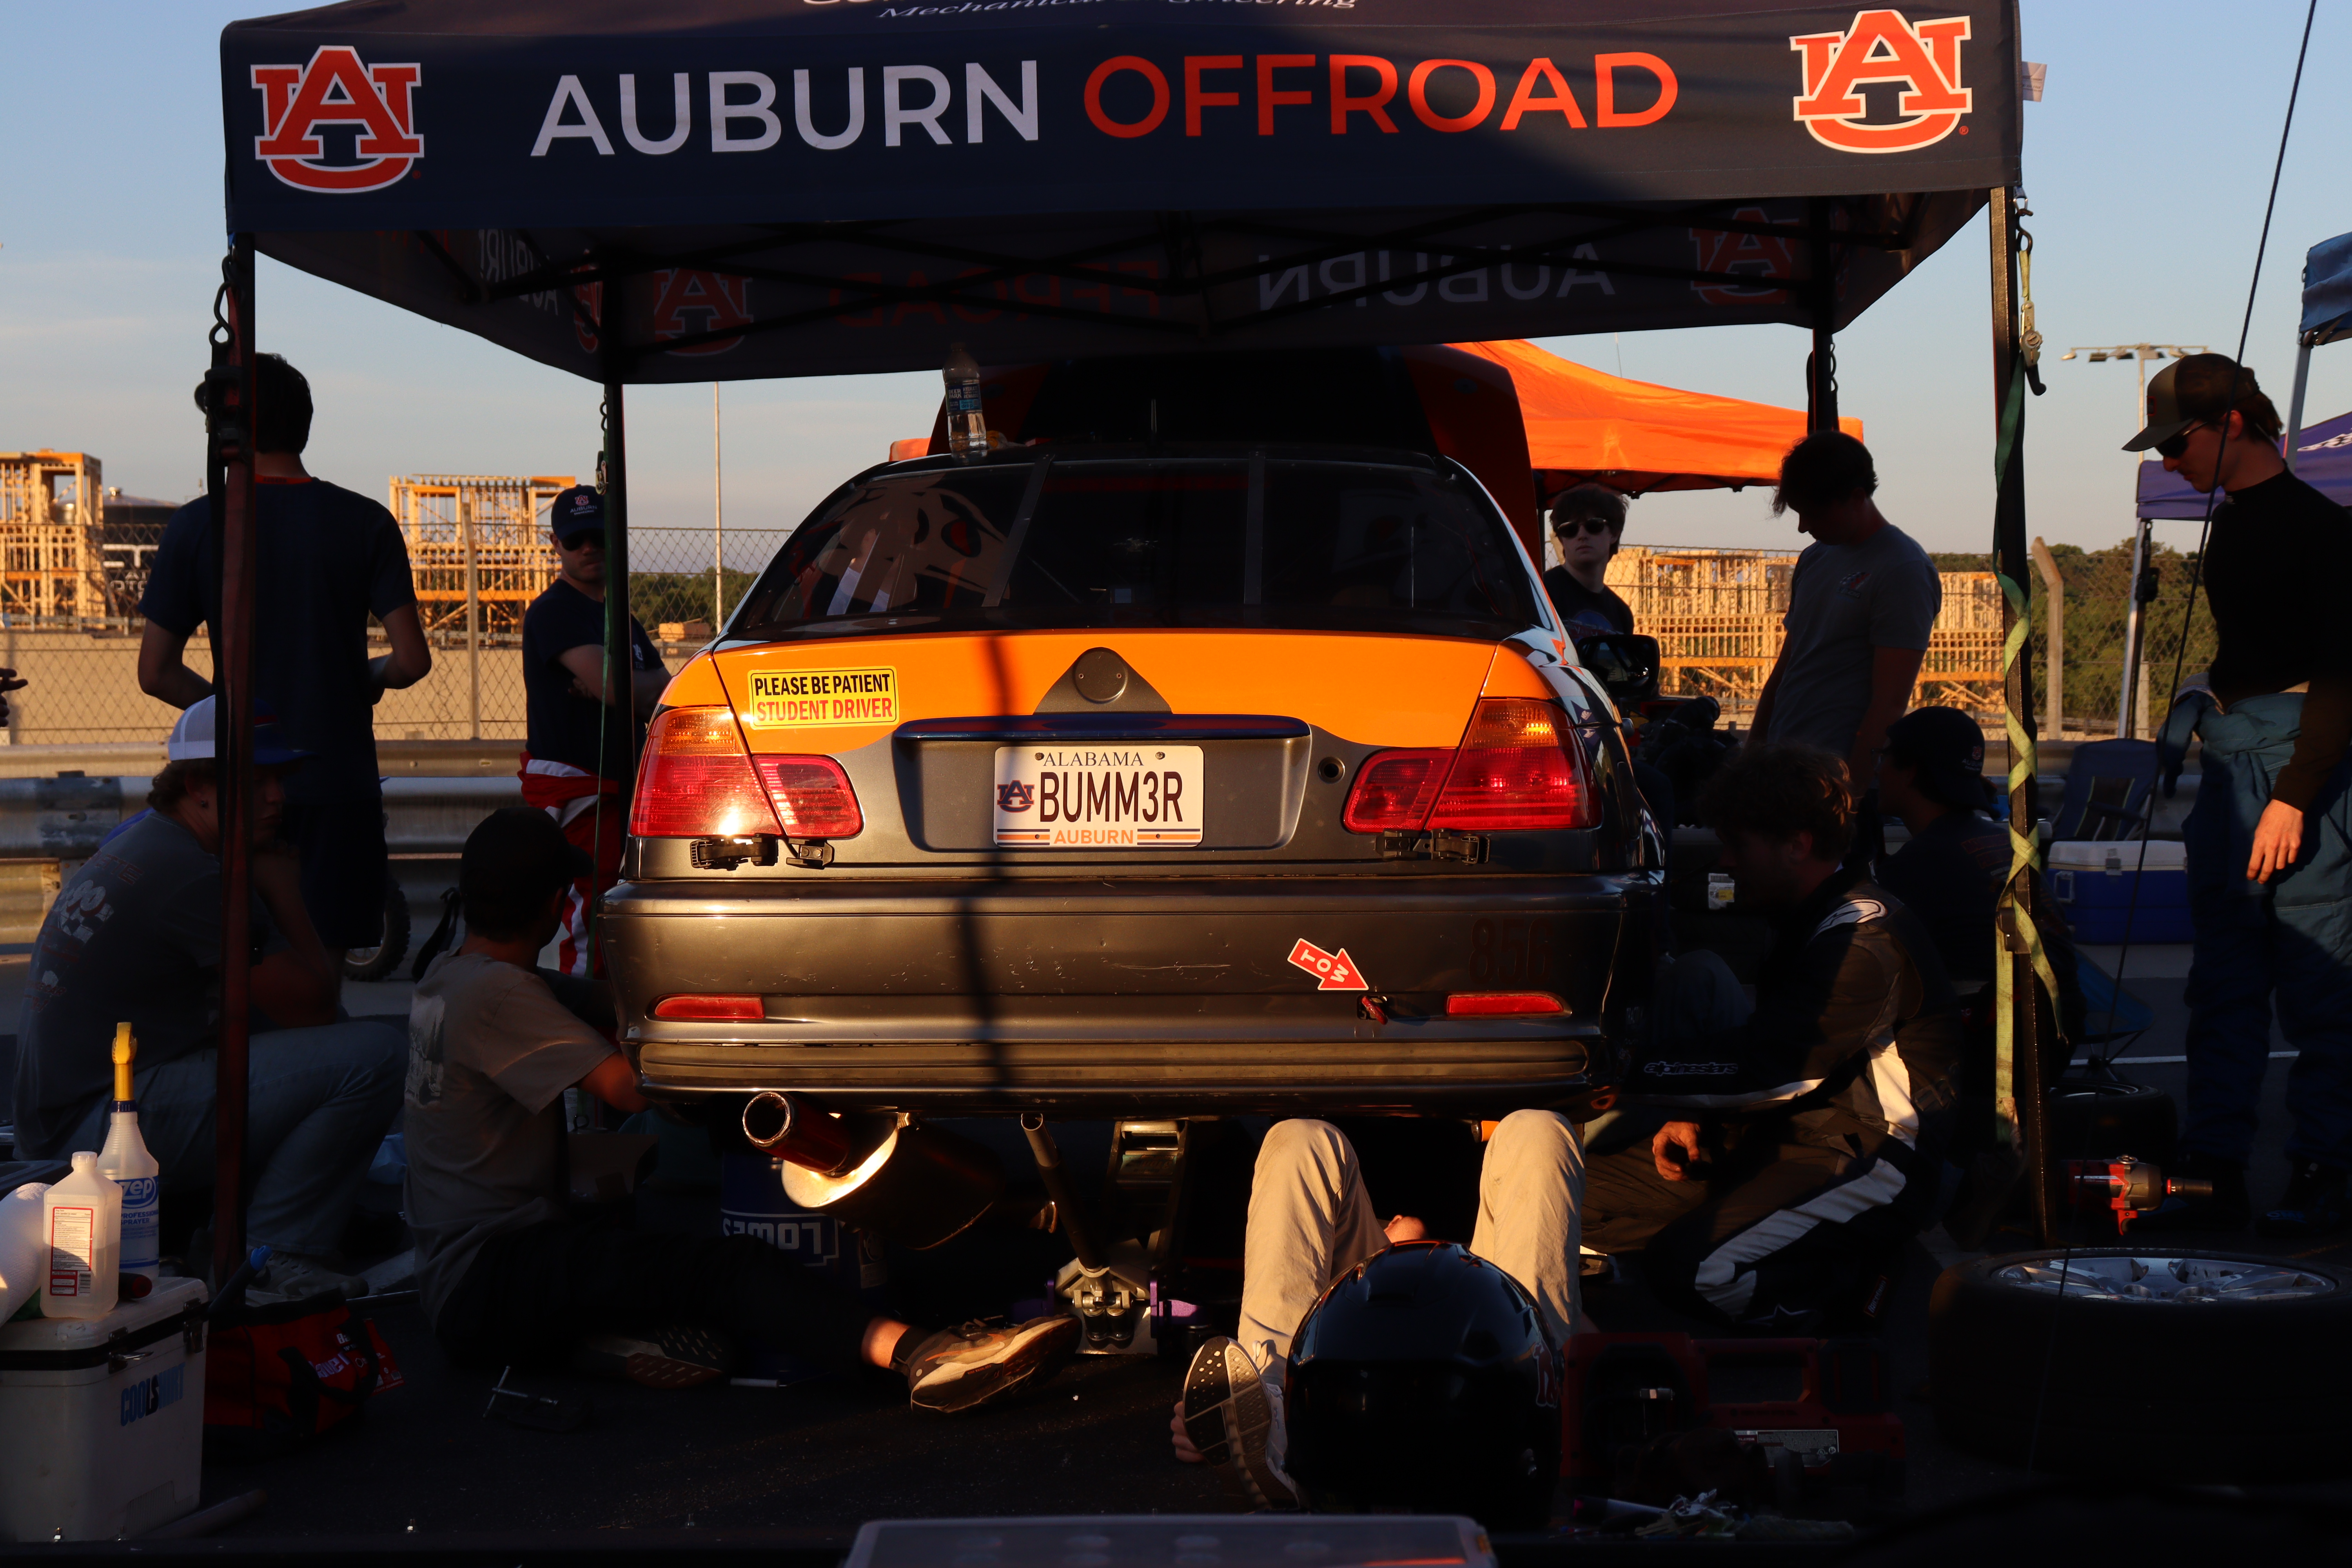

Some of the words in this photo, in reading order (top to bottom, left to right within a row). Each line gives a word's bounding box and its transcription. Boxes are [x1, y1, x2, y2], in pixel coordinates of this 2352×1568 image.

[530, 60, 1039, 156] AUBURN
[1084, 51, 1679, 138] OFFROAD
[570, 505, 597, 513] AUBURN
[755, 677, 809, 696] PLEASE
[811, 676, 830, 694] BE
[833, 674, 890, 693] PATIENT
[757, 700, 828, 722] STUDENT
[833, 697, 893, 719] DRIVER
[1044, 752, 1144, 766] ALABAMA
[1040, 771, 1183, 822] BUMM3R
[1053, 829, 1134, 844] AUBURN
[1468, 917, 1553, 985] 856
[1300, 949, 1349, 983] TOW
[1644, 1061, 1739, 1077] alpinestars
[120, 1362, 185, 1427] COOLSHIRT
